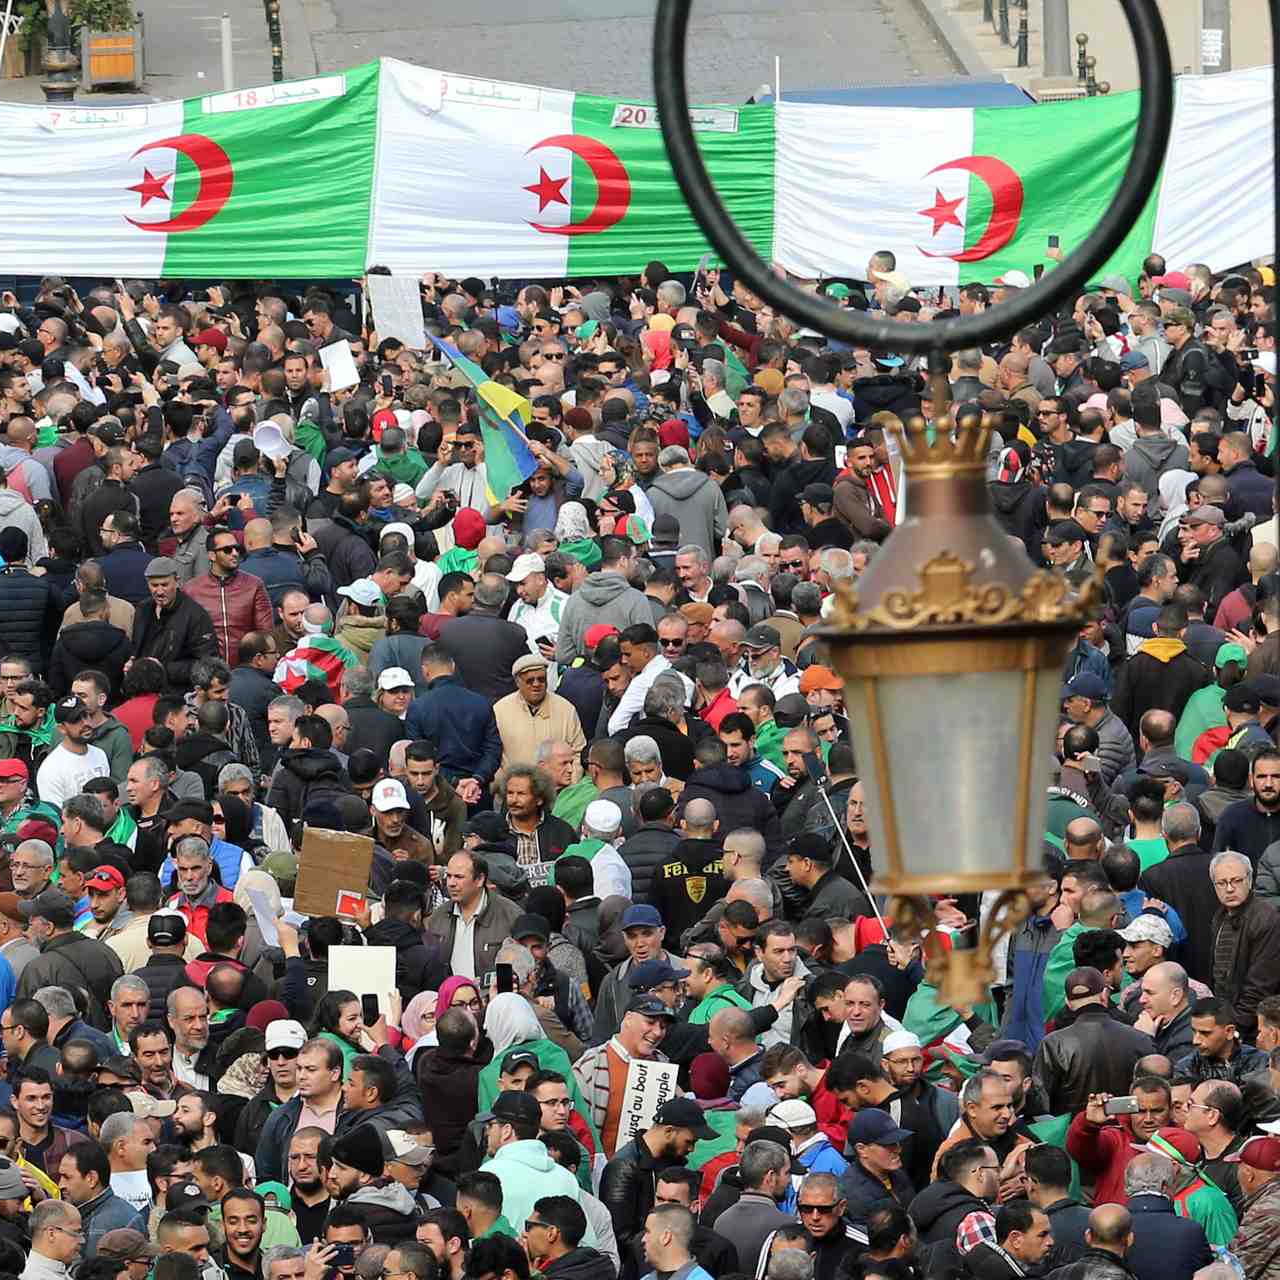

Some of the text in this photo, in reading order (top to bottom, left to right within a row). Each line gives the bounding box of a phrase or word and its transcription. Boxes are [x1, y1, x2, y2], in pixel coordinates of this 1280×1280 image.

[235, 92, 257, 108] 18
[621, 107, 648, 124] 20
[632, 1063, 648, 1092] bout
